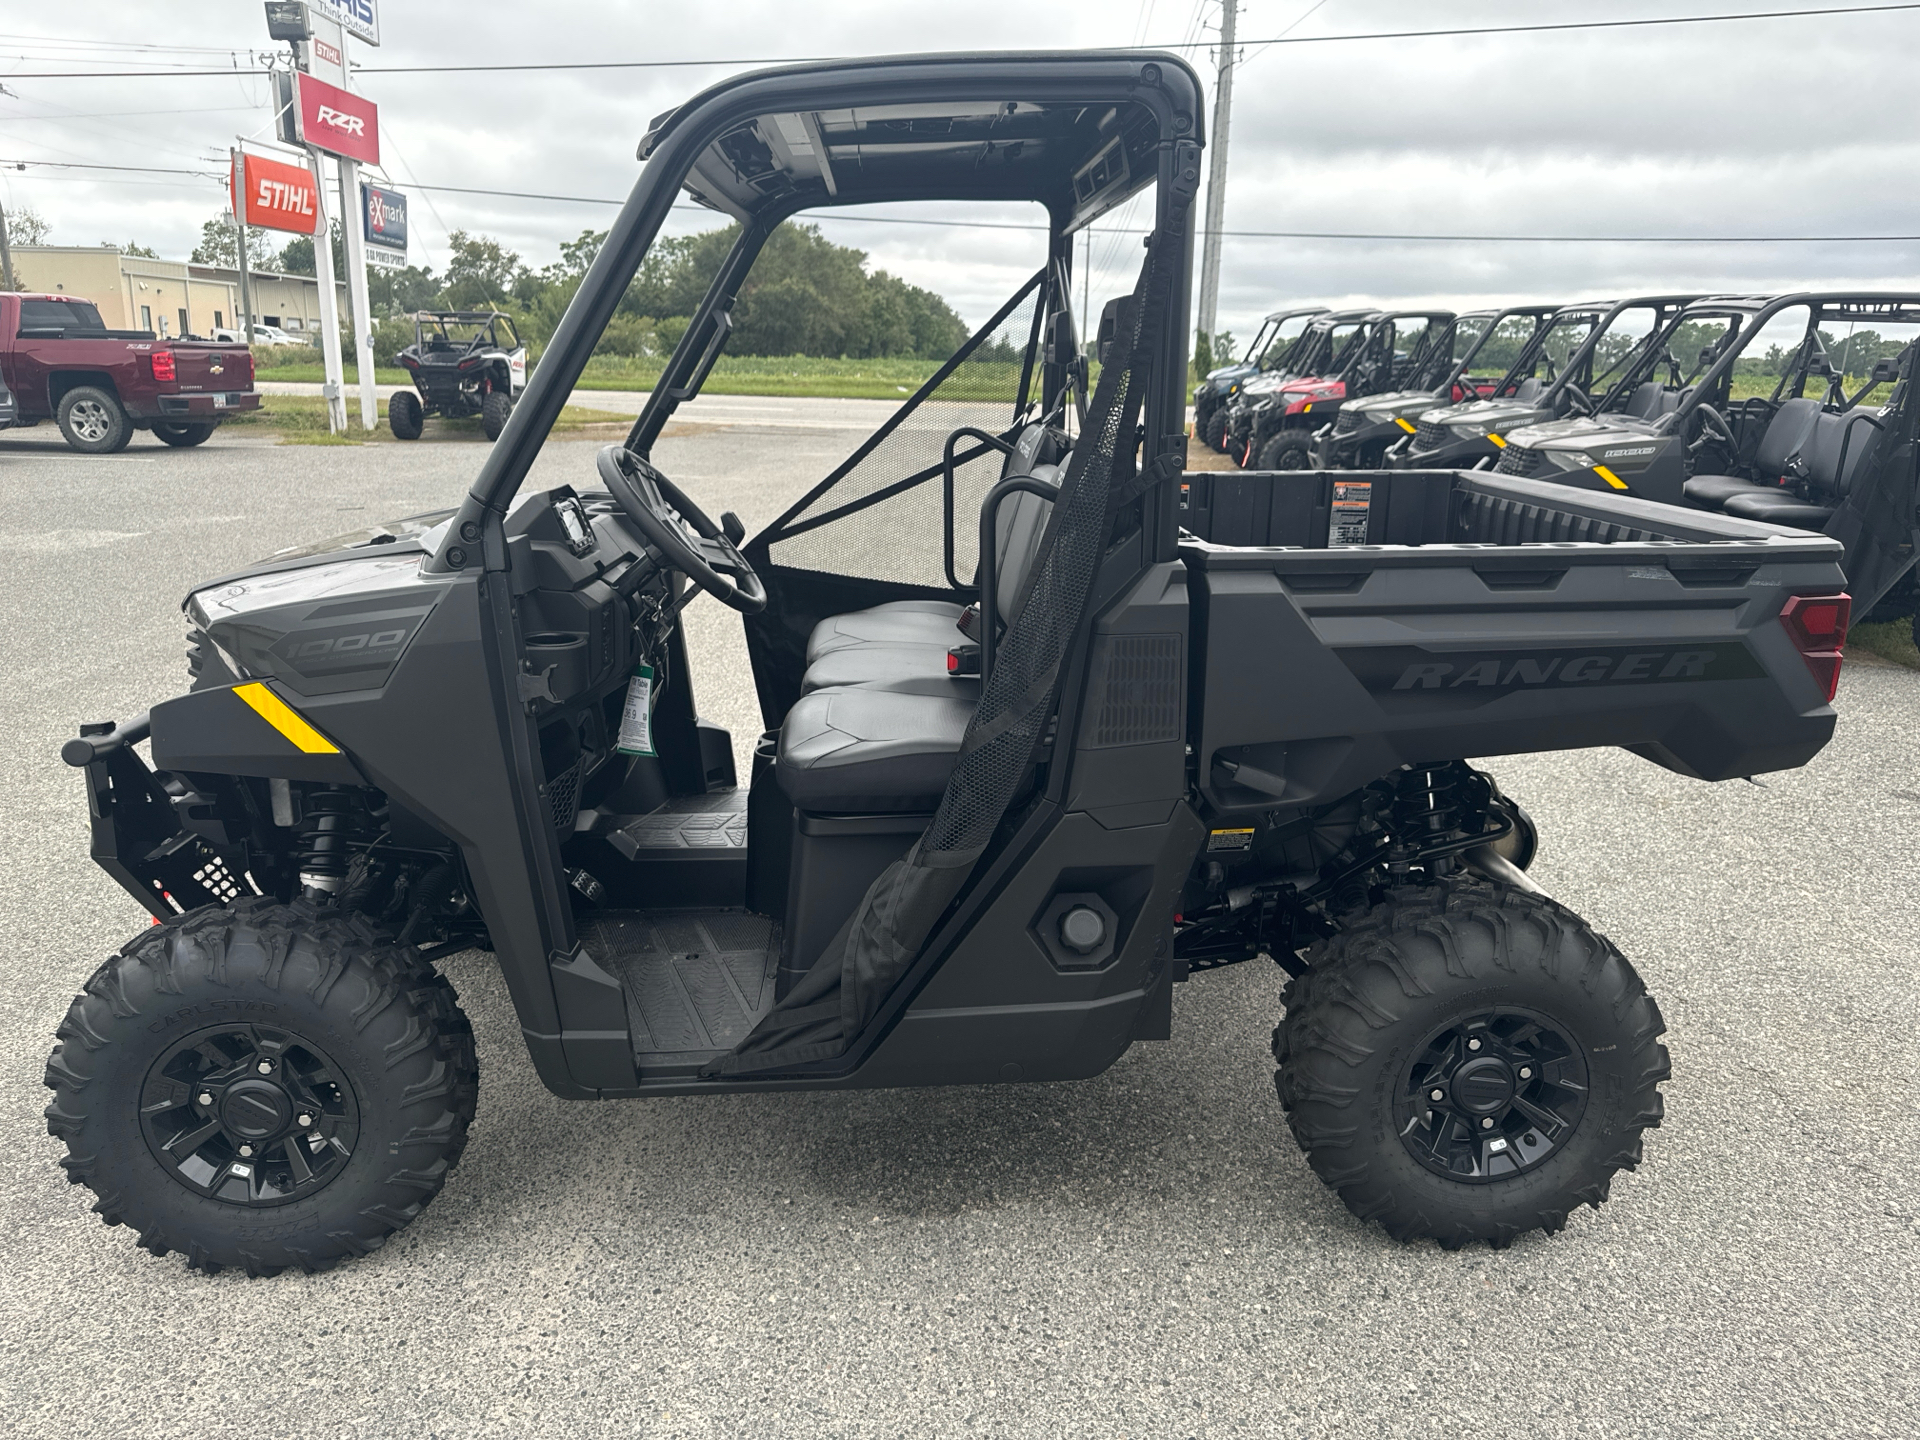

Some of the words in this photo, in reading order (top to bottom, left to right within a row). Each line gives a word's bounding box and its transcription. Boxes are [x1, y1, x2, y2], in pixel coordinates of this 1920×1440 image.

[318, 0, 343, 22] Think
[343, 14, 374, 39] Outside
[316, 42, 341, 64] STIHL
[317, 104, 365, 137] RZR
[257, 178, 313, 216] STIHL
[376, 250, 390, 264] POWER
[390, 253, 405, 267] SPORTS
[1604, 446, 1656, 458] 1000
[286, 628, 407, 659] 1000
[1391, 651, 1718, 690] RANGER
[147, 999, 280, 1033] CARLSTAR
